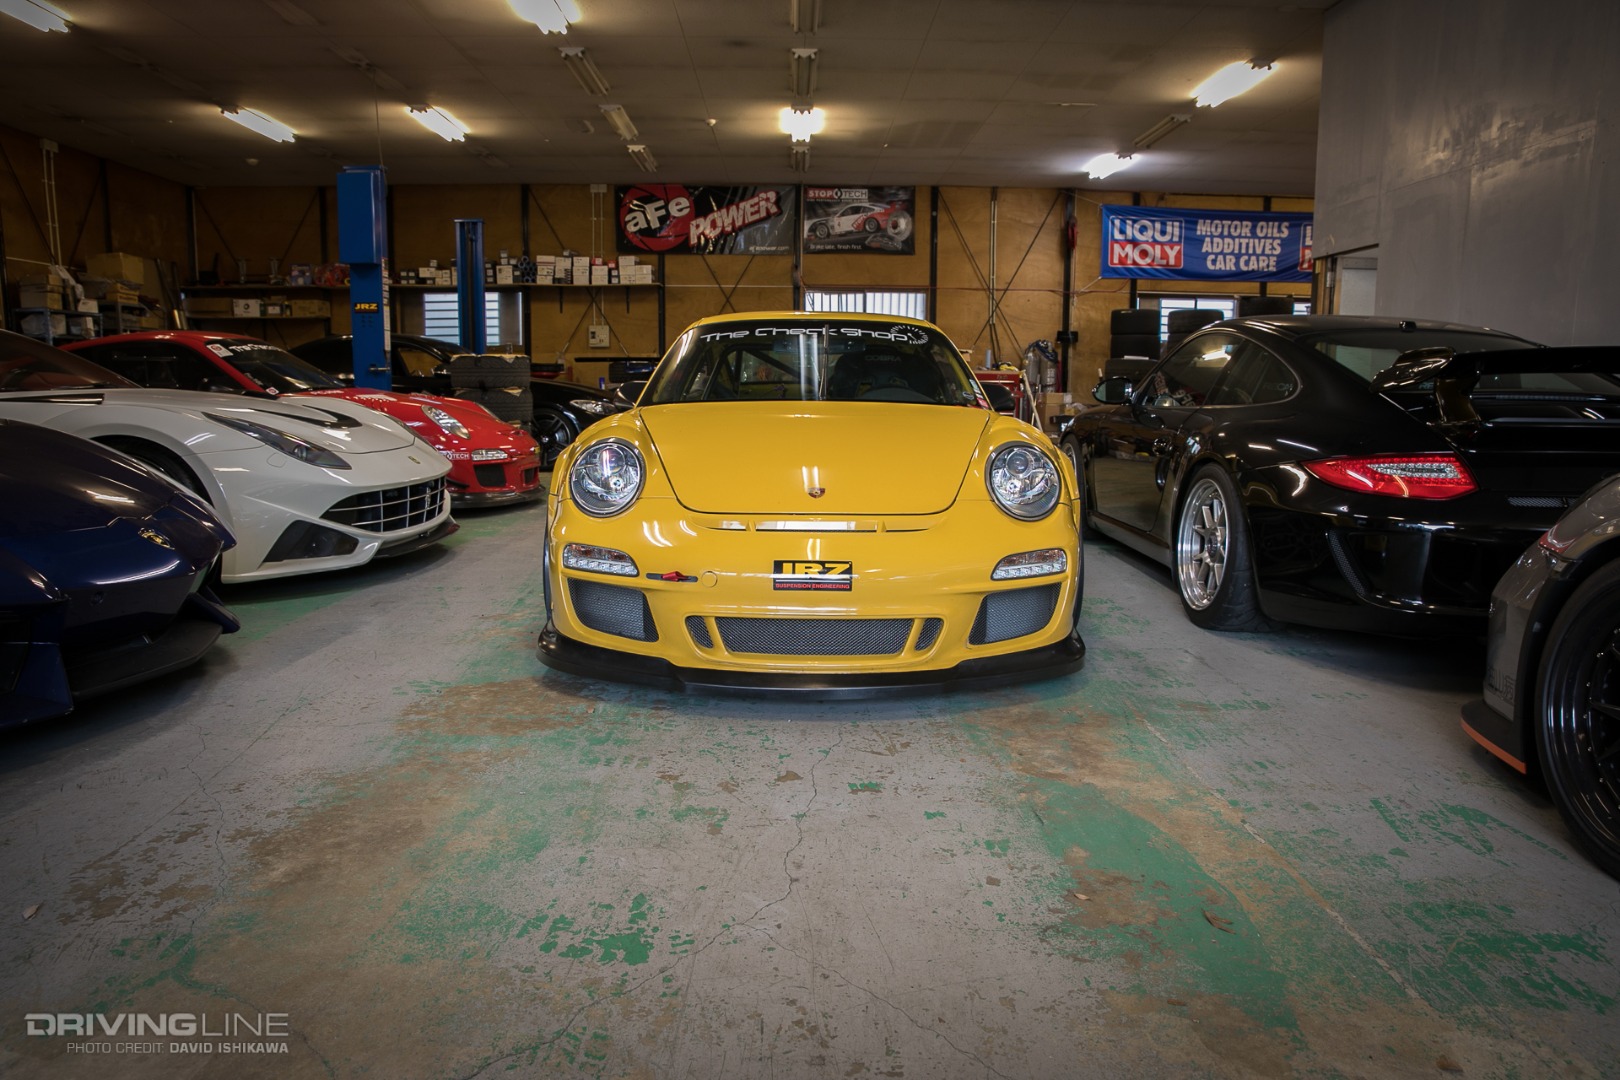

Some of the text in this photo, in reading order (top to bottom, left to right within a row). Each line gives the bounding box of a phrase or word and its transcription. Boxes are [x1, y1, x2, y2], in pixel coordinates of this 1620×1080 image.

[624, 196, 691, 233] aFe
[689, 190, 779, 246] POWER
[1113, 219, 1180, 242] LIQUI
[1196, 219, 1290, 238] MOTOR OILS
[1113, 244, 1181, 266] MOLY
[1201, 237, 1282, 255] ADDITIVES
[1206, 254, 1277, 272] CAR CARE
[700, 330, 749, 342] The
[840, 328, 908, 342] Shop
